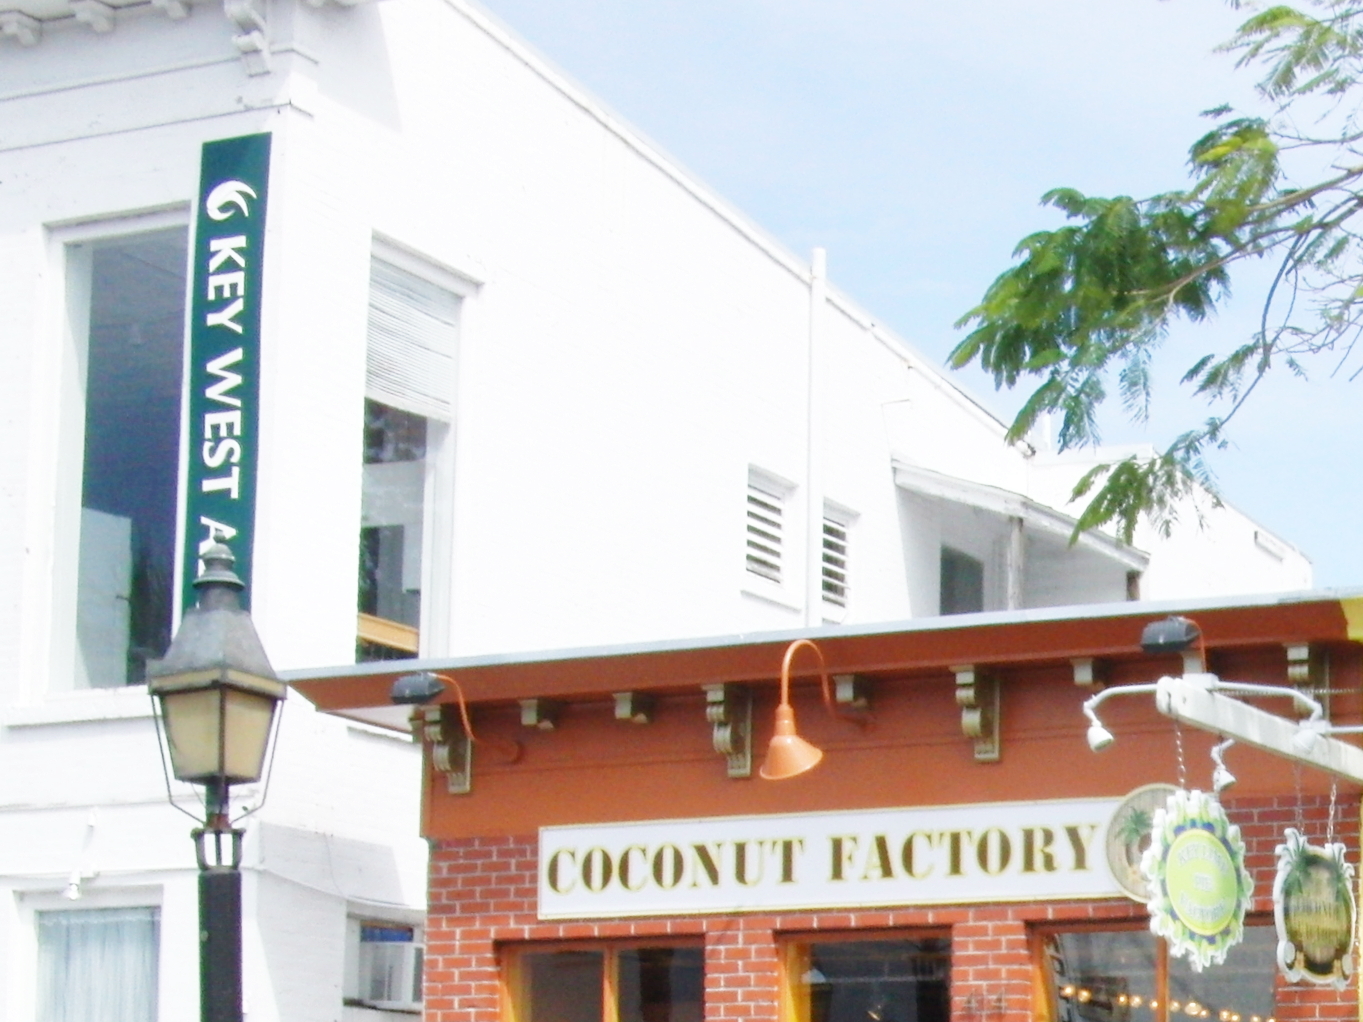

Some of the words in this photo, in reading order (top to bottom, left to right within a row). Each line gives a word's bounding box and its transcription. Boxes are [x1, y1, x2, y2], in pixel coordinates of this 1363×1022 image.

[206, 235, 247, 334] KEY
[201, 347, 243, 499] WEST
[546, 837, 803, 895] COCONUT
[827, 823, 1101, 882] FACTORY
